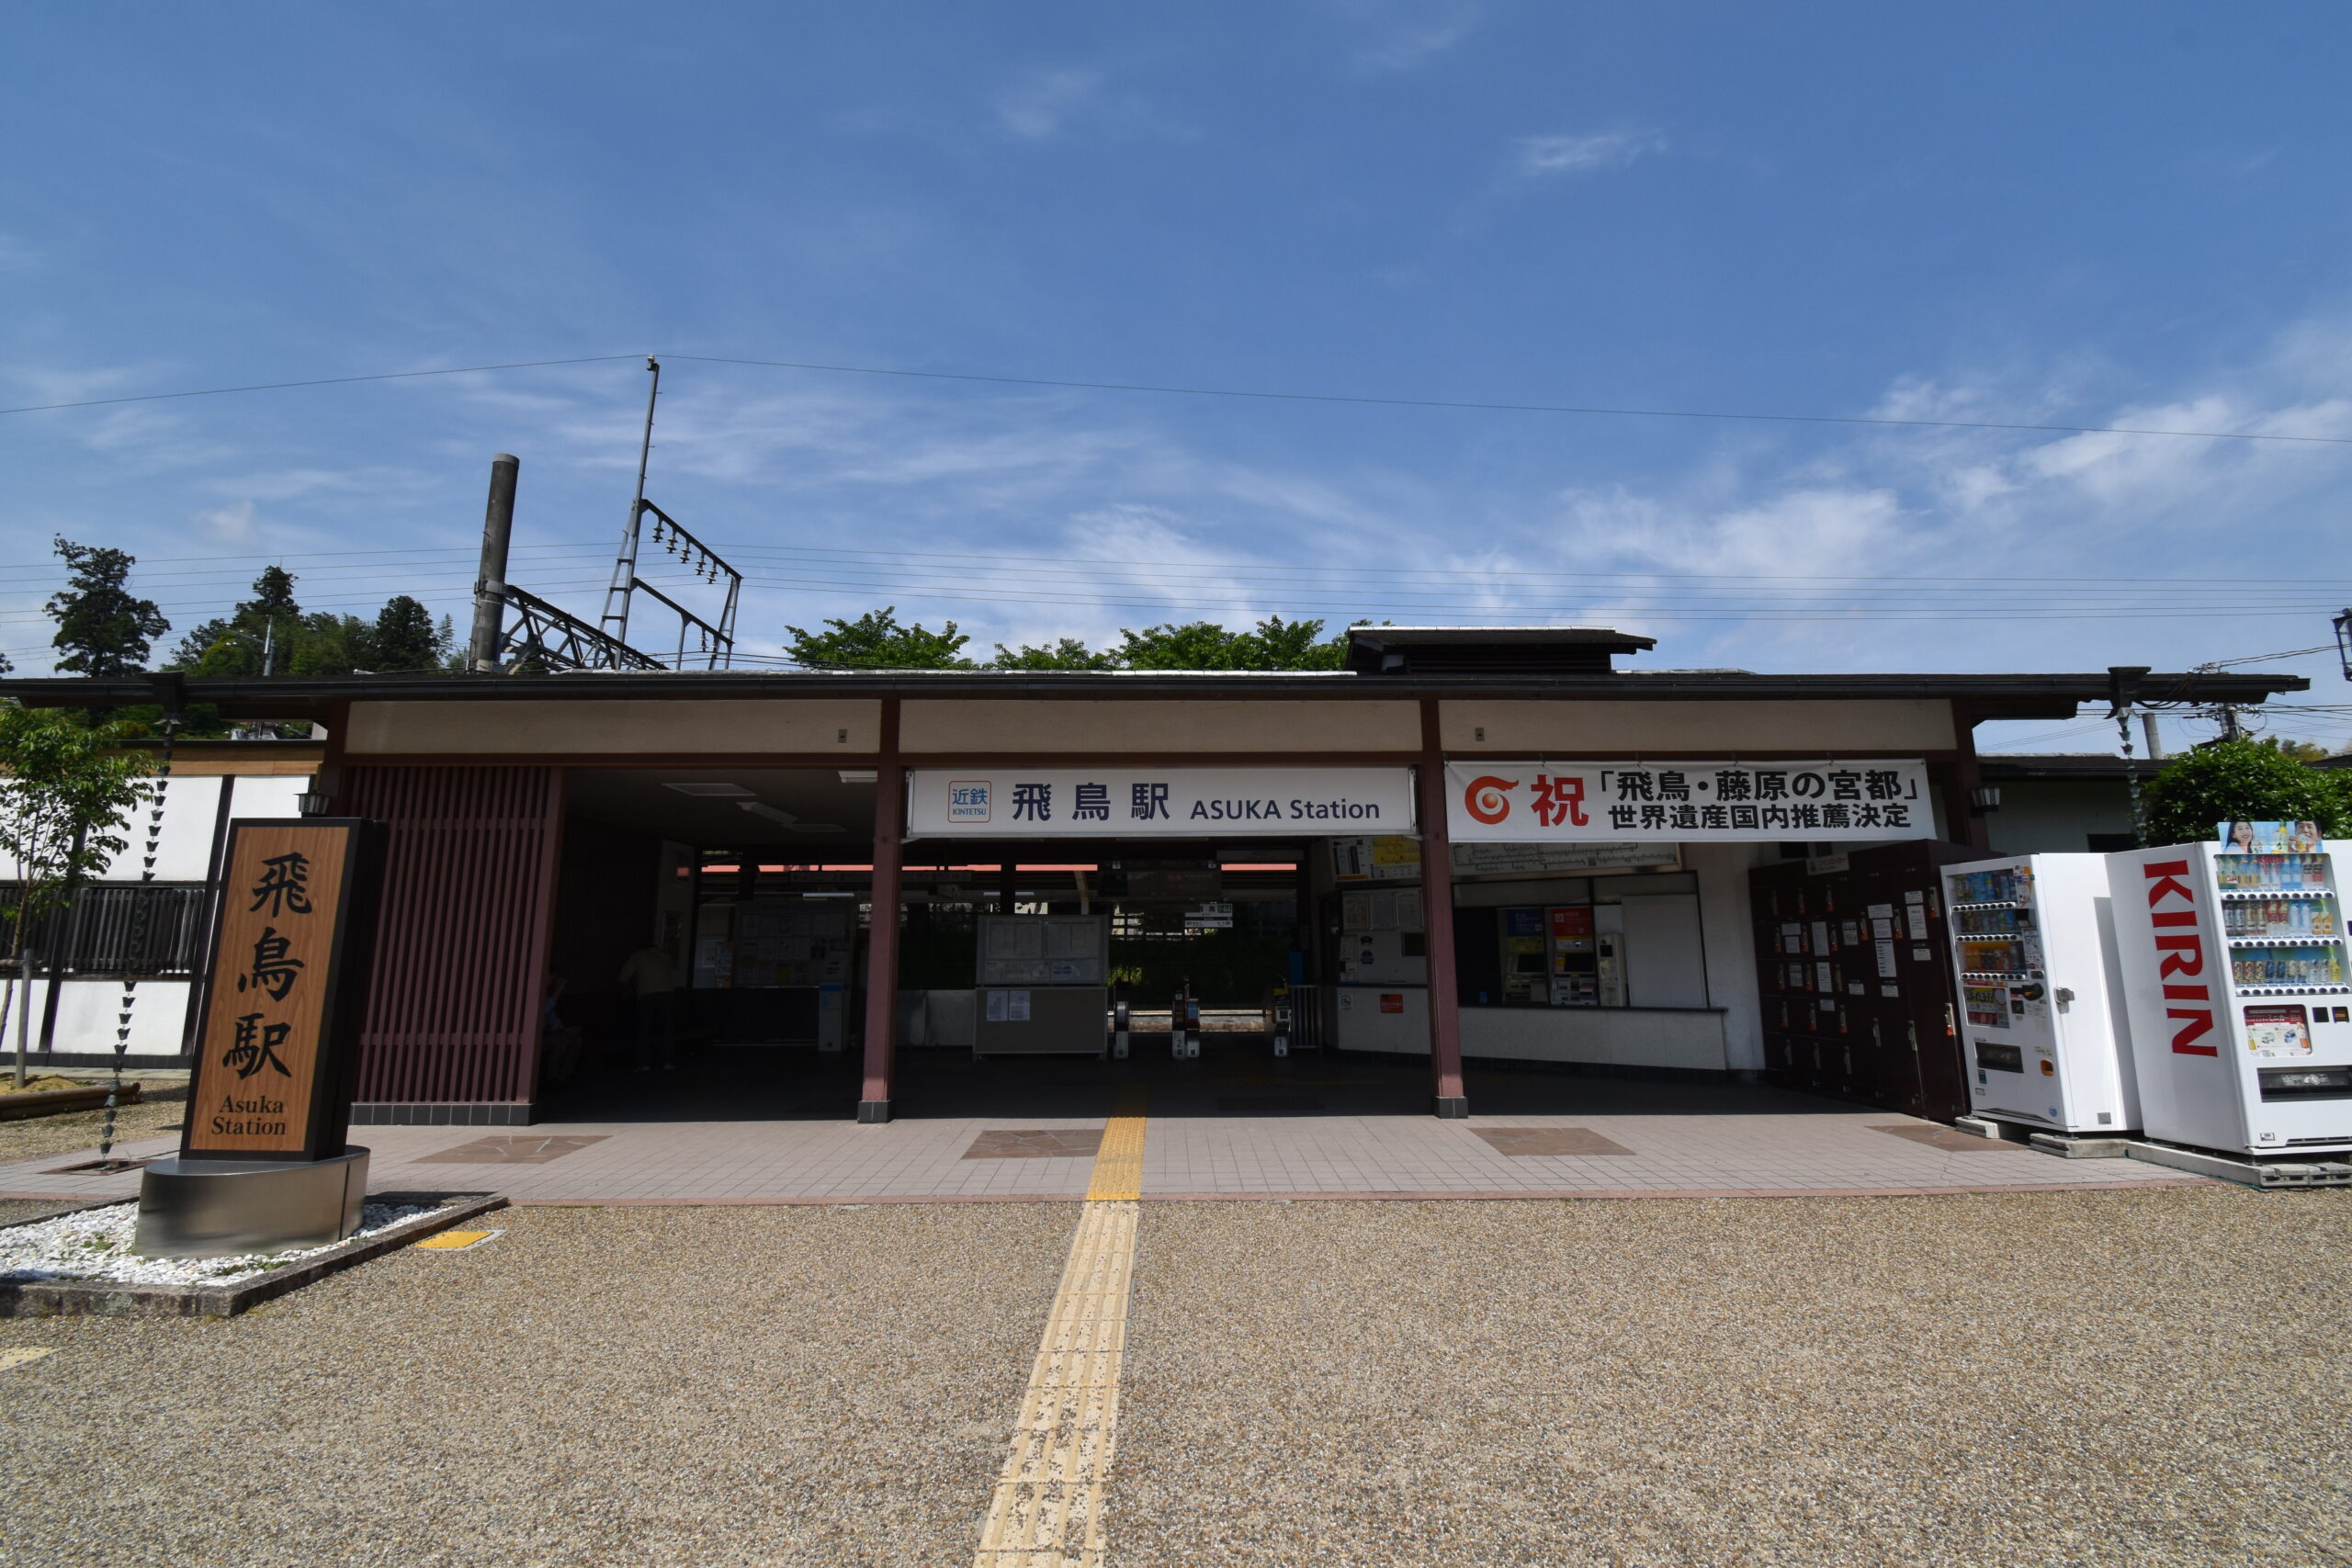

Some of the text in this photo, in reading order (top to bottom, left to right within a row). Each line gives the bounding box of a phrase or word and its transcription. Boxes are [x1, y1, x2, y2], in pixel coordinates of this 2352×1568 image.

[952, 788, 988, 806] 近鉄
[1531, 774, 1589, 827] 祝
[1600, 770, 1918, 802] 「飛鳥・藤原の宮都」
[952, 807, 987, 816] KINTETSU
[1012, 783, 1380, 821] 飛鳥駅 ASUKA Station
[1608, 803, 1912, 829] 世界遺産国内推薦決定
[222, 852, 312, 1079] 飛鳥駅
[2143, 860, 2218, 1058] KIRIN
[220, 1095, 283, 1113] Asuka
[211, 1117, 287, 1135] Station
